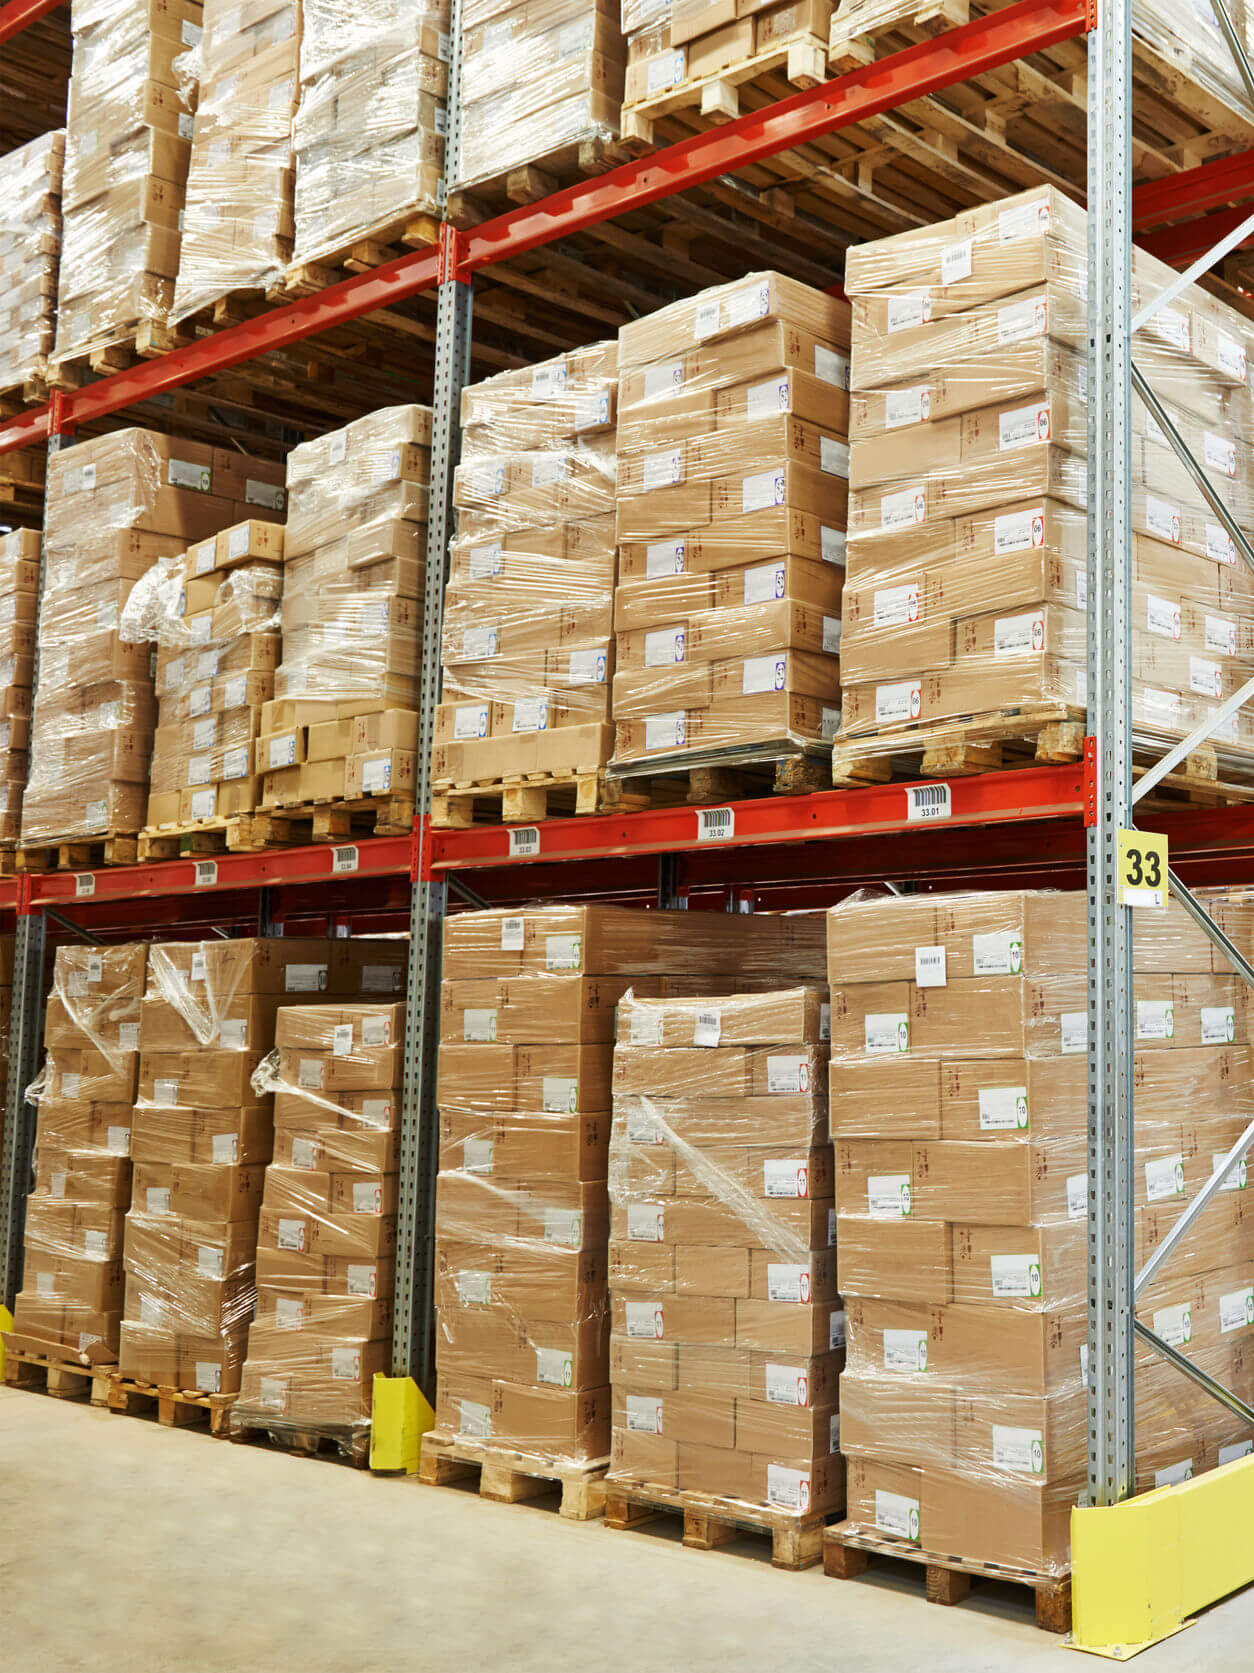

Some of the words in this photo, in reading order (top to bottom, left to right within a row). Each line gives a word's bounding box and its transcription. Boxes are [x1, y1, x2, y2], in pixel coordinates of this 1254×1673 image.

[1040, 418, 1048, 426] 06
[1033, 524, 1041, 533] 06
[921, 807, 940, 817] 33.01
[1126, 849, 1161, 887] 33
[900, 1031, 907, 1039] 10
[1018, 1106, 1026, 1114] 10
[1031, 1273, 1039, 1282] 10
[1034, 1449, 1041, 1458] 10
